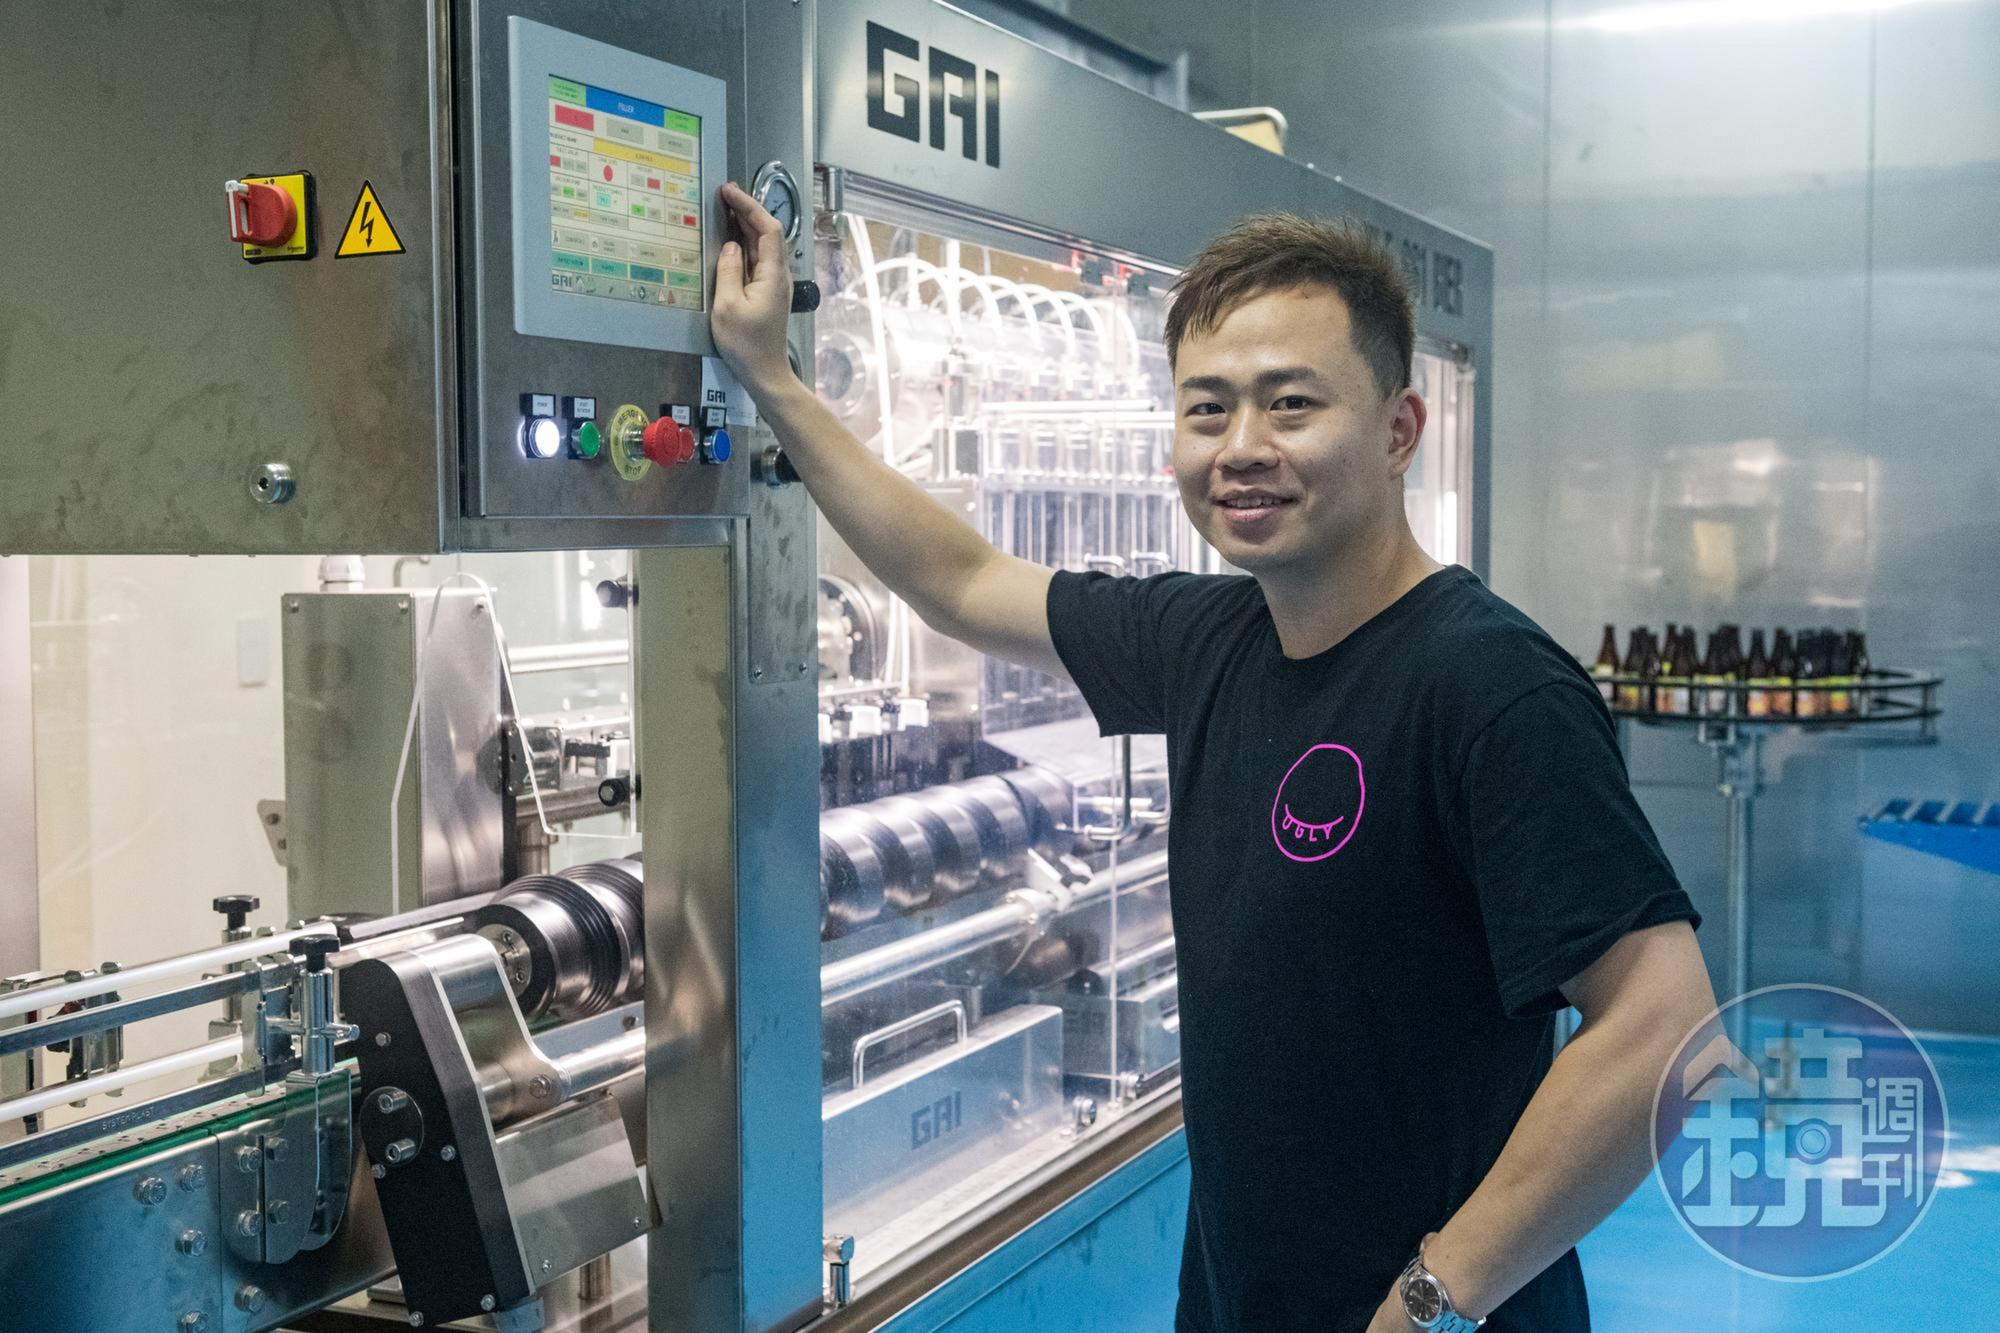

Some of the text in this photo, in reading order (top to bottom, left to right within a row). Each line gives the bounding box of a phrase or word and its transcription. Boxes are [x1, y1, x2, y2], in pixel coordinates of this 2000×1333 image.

[866, 19, 1000, 169] GAI
[706, 389, 726, 404] GAI
[624, 464, 642, 476] STOP
[1282, 815, 1334, 842] UGLY
[911, 1090, 961, 1150] GAI
